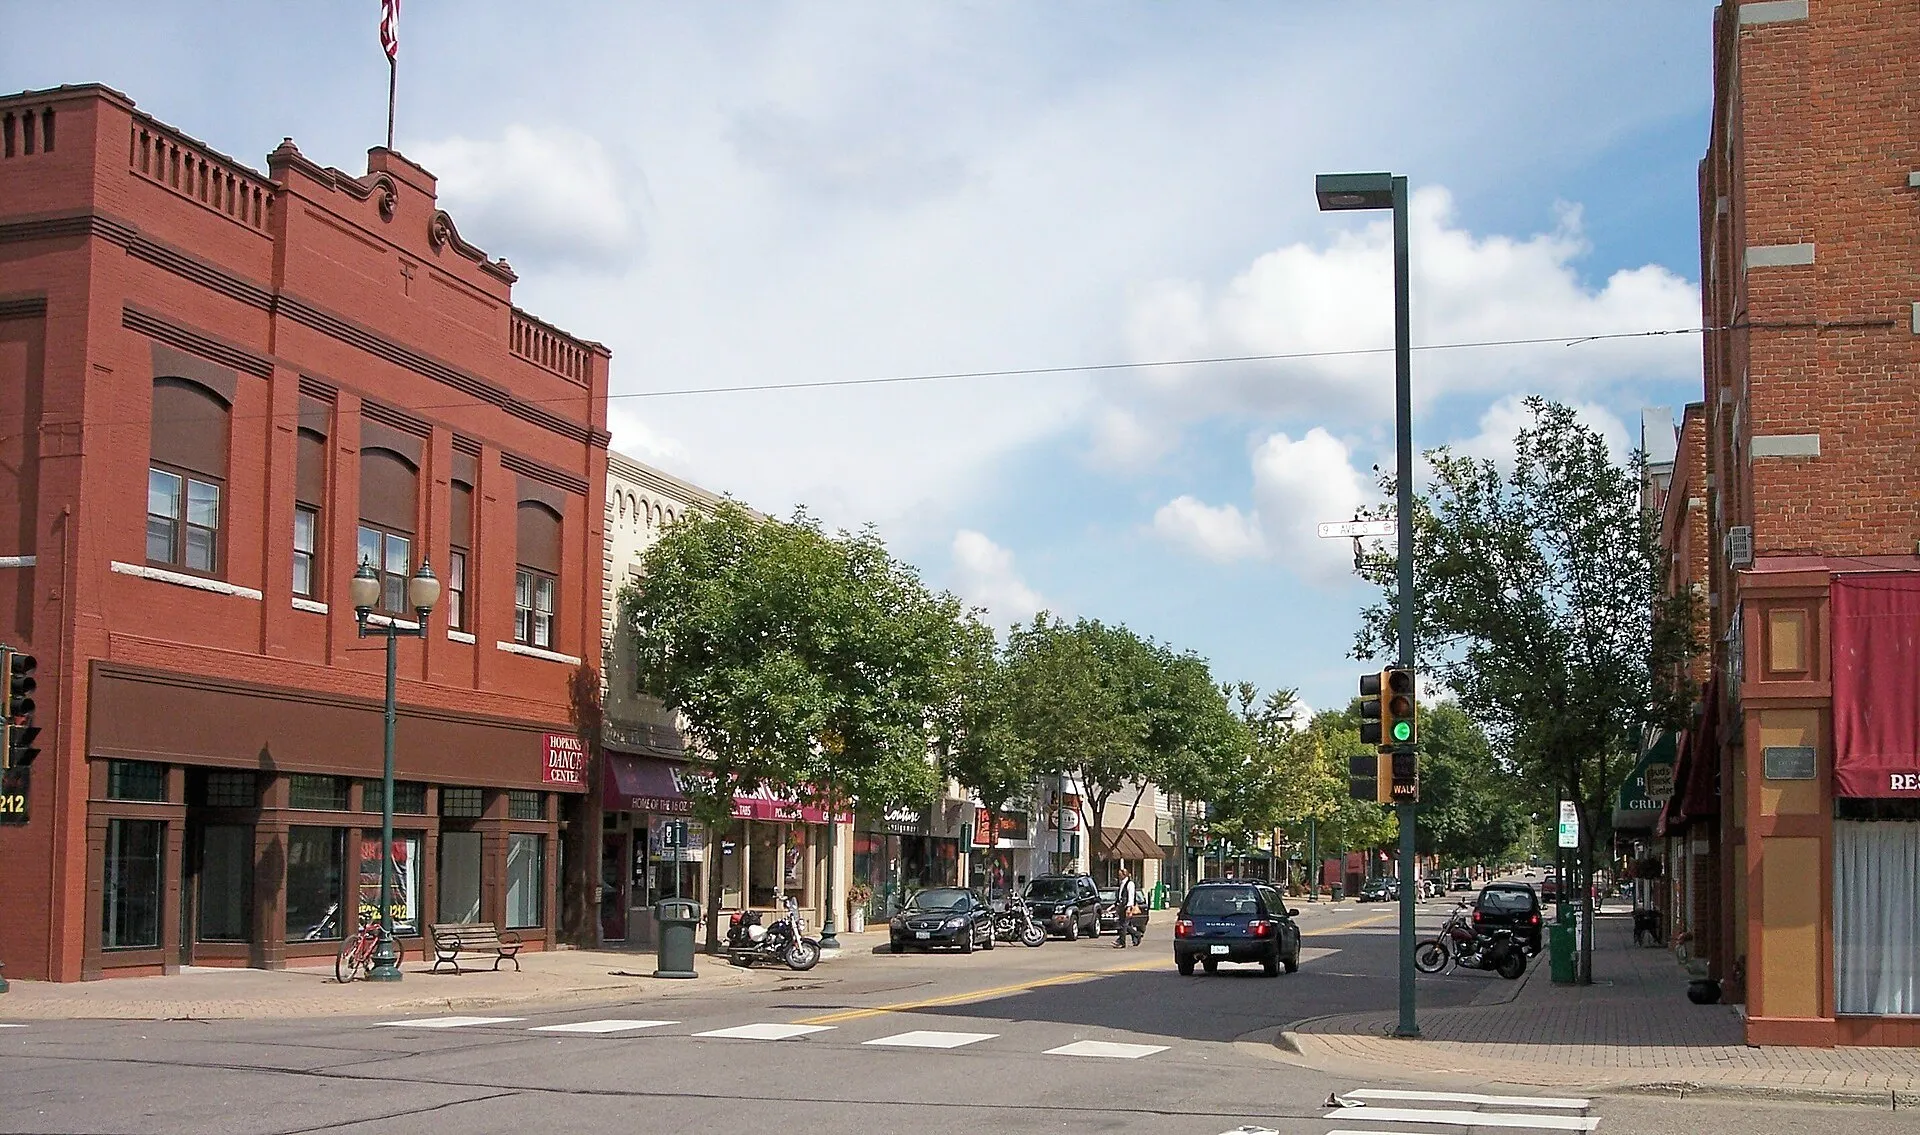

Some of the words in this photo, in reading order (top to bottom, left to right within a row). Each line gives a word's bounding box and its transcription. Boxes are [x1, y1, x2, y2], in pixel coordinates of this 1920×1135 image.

[1340, 523, 1357, 535] AVE
[1362, 523, 1369, 534] S
[550, 735, 581, 750] HOPKINS
[548, 750, 583, 769] DANCE
[550, 769, 580, 783] CENTER
[1393, 785, 1416, 794] WALK
[631, 797, 651, 810] HOME
[650, 798, 659, 811] OF
[660, 799, 670, 812] THE
